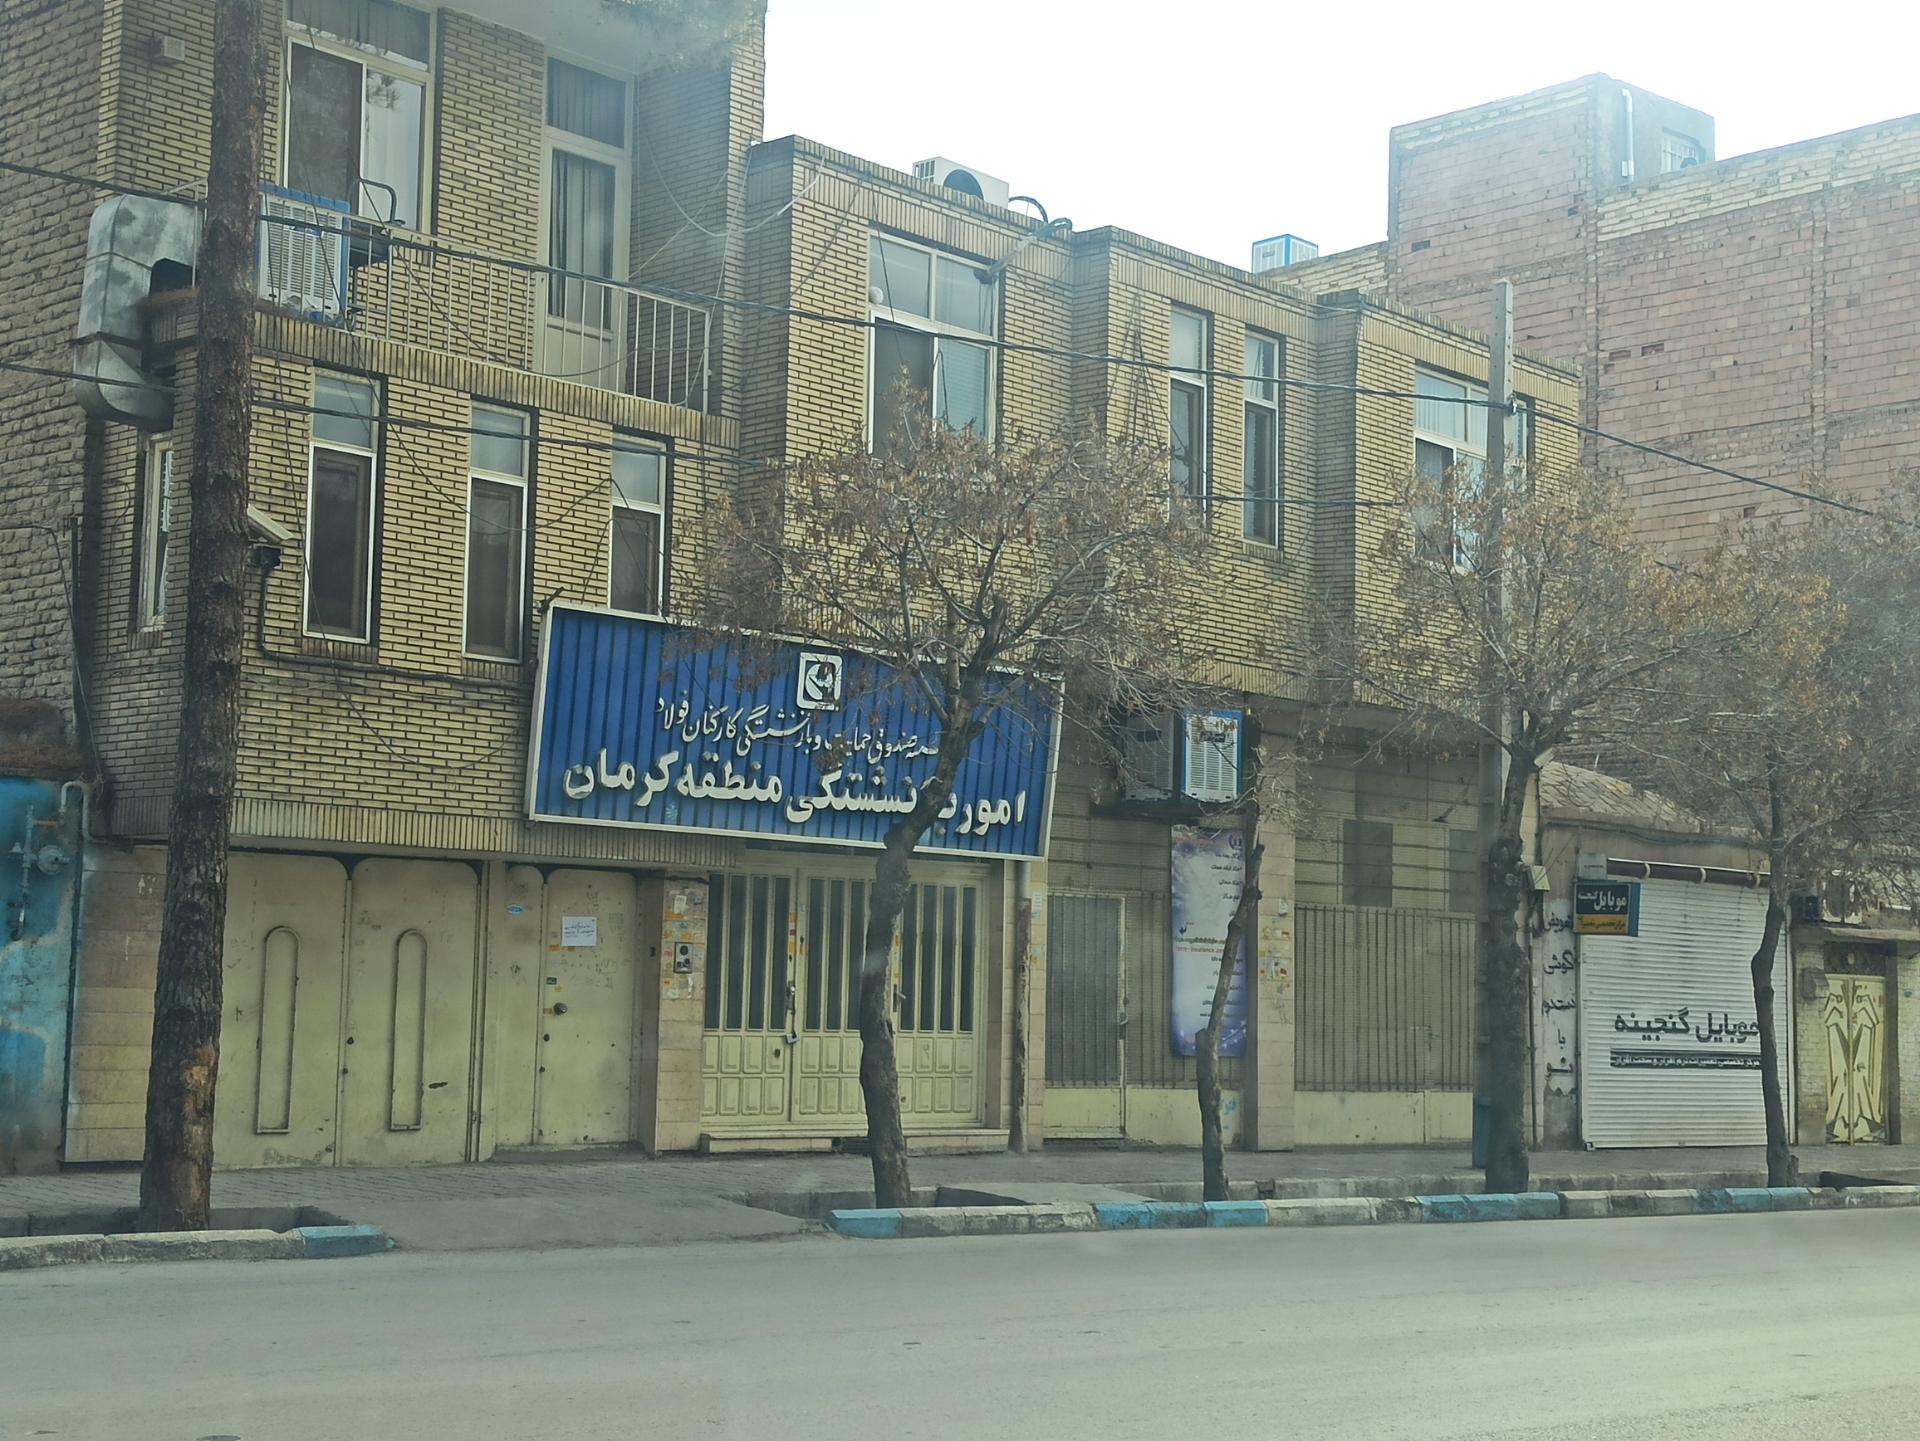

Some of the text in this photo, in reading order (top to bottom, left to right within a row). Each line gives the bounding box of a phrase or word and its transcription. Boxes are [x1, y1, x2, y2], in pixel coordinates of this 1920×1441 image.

[655, 689, 689, 730] فولاد
[682, 704, 744, 742] کارکنان
[564, 747, 680, 807] کرمان
[676, 751, 783, 804] منطقه
[954, 790, 1026, 836] امور
[1614, 1006, 1759, 1044] موبایل گنجینه
